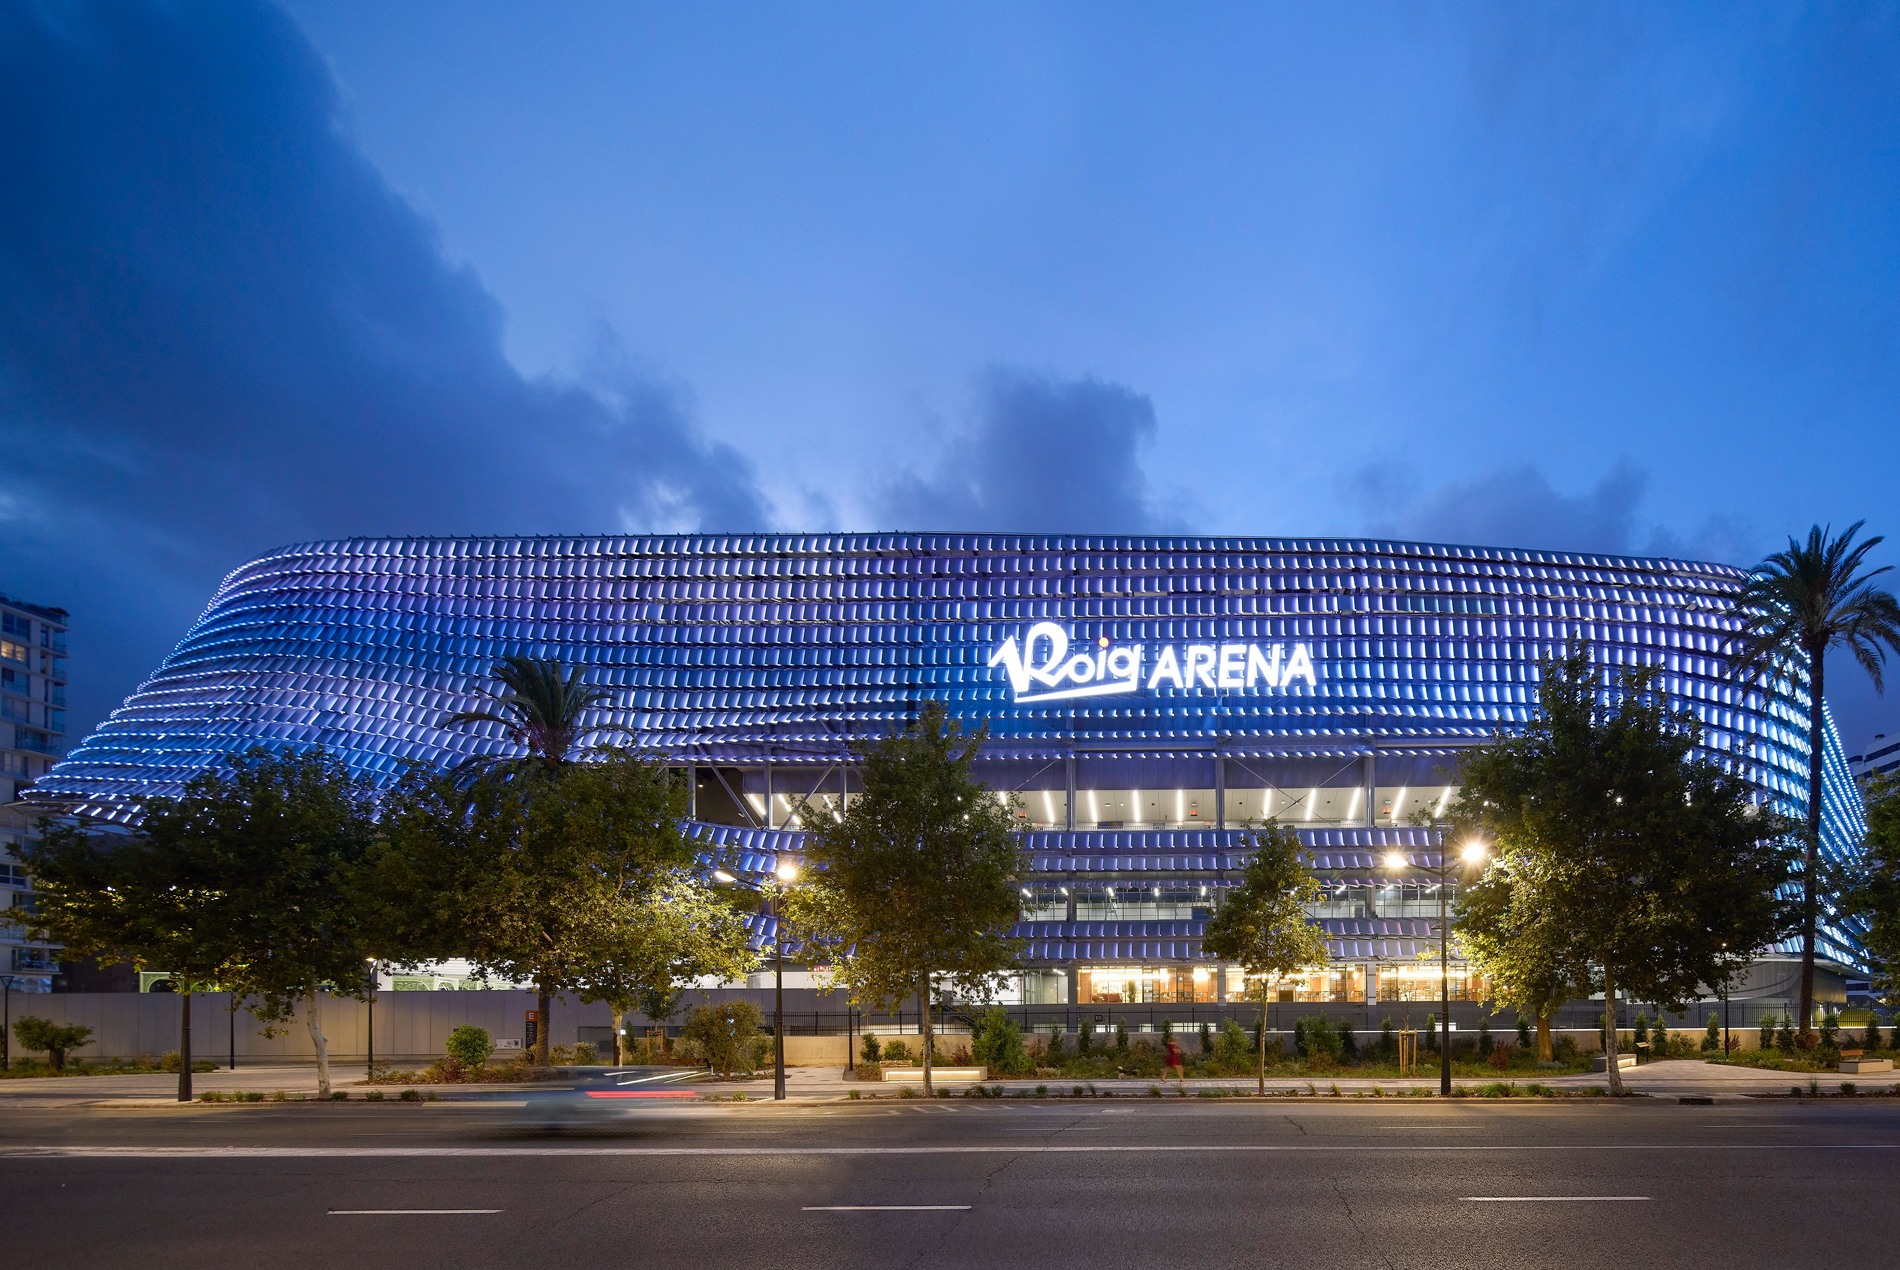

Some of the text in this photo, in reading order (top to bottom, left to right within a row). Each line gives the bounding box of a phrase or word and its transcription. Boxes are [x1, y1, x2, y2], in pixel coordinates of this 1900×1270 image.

[987, 621, 1317, 703] Roig ARENA
[528, 1012, 534, 1020] E
